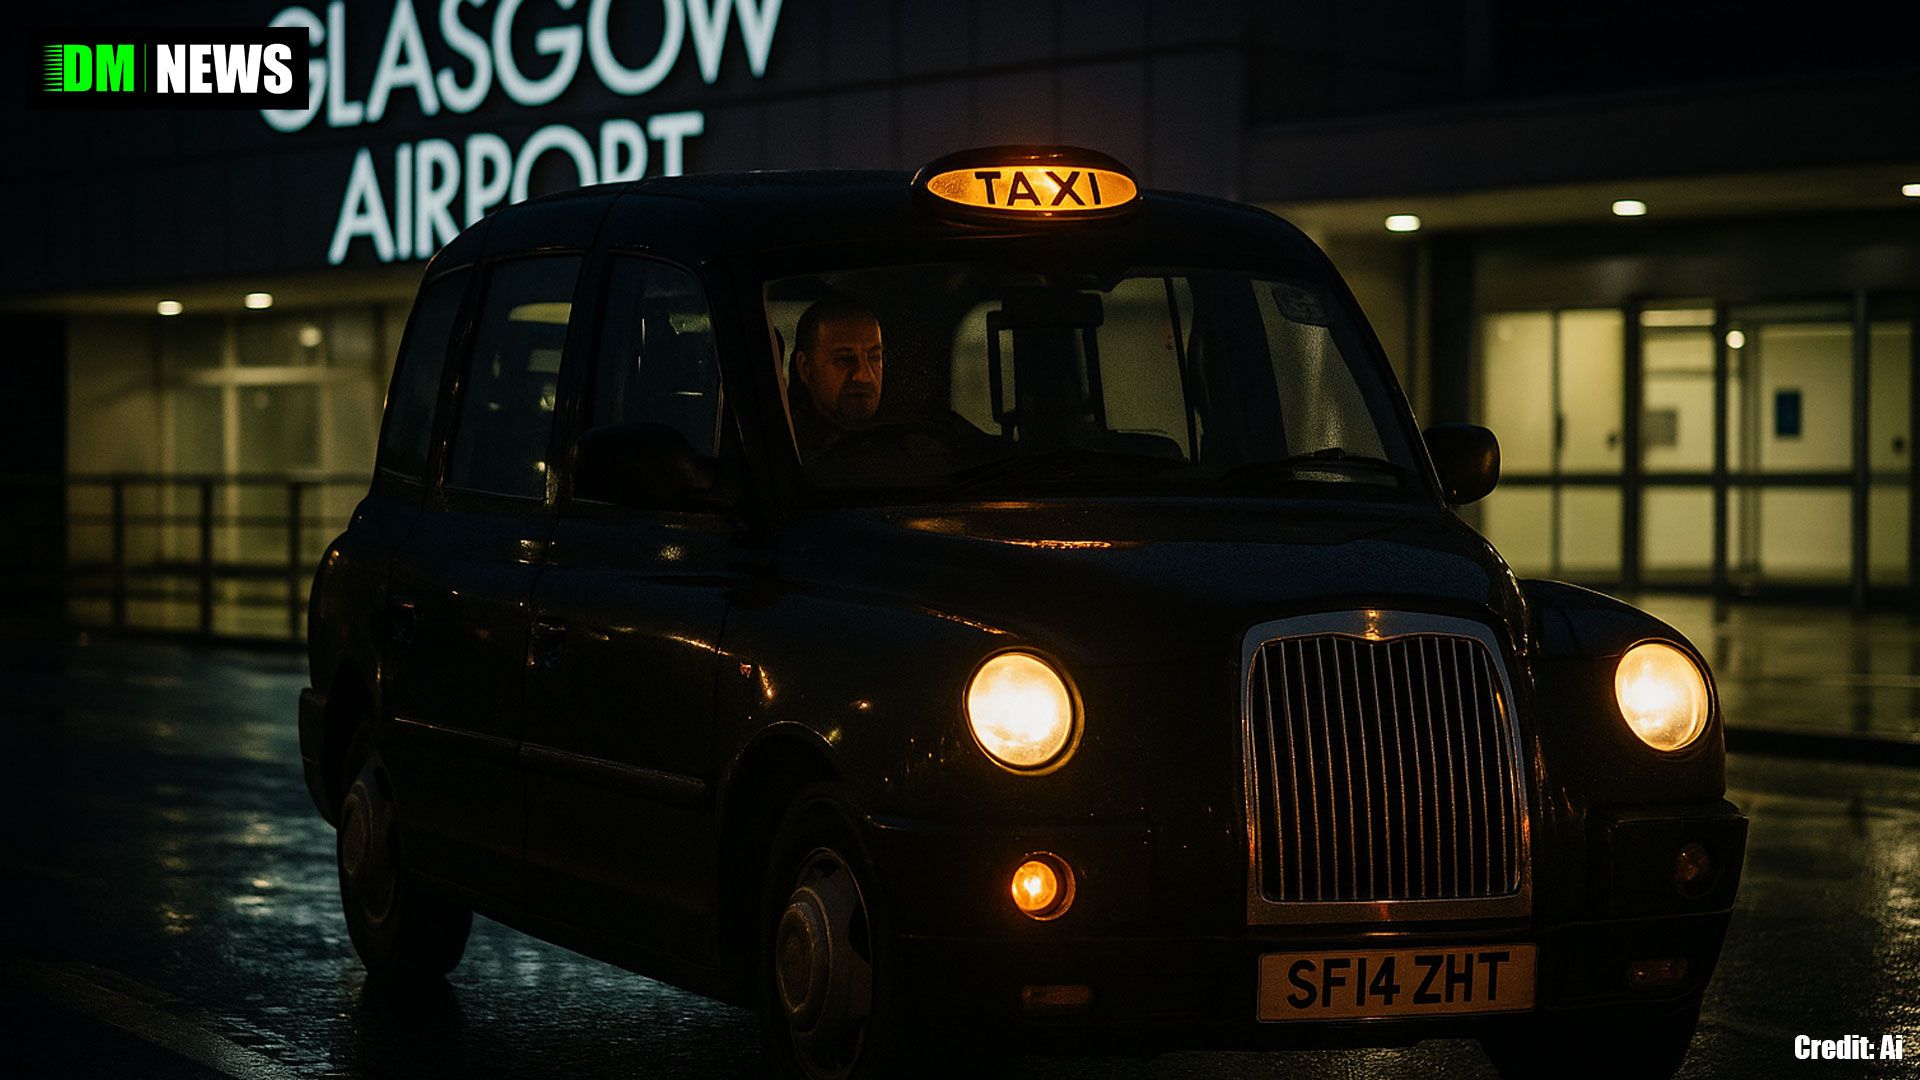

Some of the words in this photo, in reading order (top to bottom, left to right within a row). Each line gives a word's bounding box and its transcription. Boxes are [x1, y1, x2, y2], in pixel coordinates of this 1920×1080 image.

[259, 0, 784, 132] GLASGOW
[974, 171, 1102, 207] TAXI
[1413, 952, 1510, 1004] ZHT
